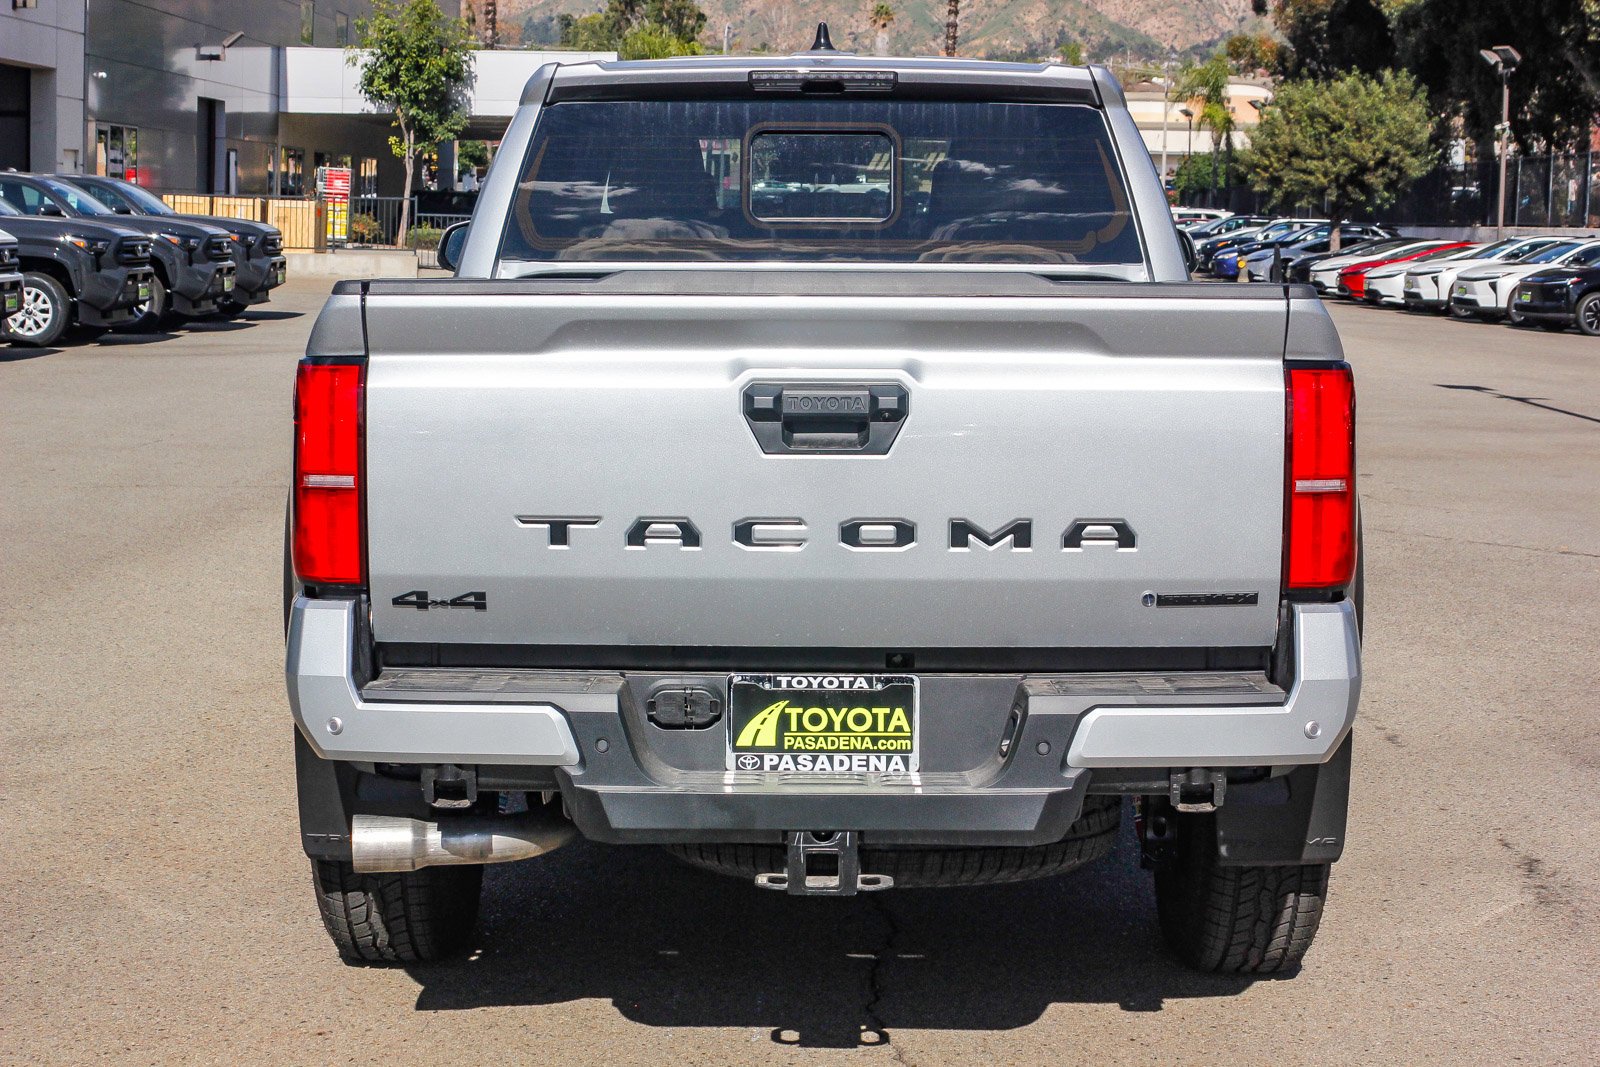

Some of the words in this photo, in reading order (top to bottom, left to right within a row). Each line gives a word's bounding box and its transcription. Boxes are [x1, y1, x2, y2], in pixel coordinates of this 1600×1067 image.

[787, 396, 865, 410] TOYOTA
[514, 515, 1139, 553] TACOMA
[777, 676, 869, 689] TOYOTA
[784, 707, 911, 732] TOYOTA
[784, 736, 911, 750] PASADENA.com
[764, 755, 906, 772] PASADENA
